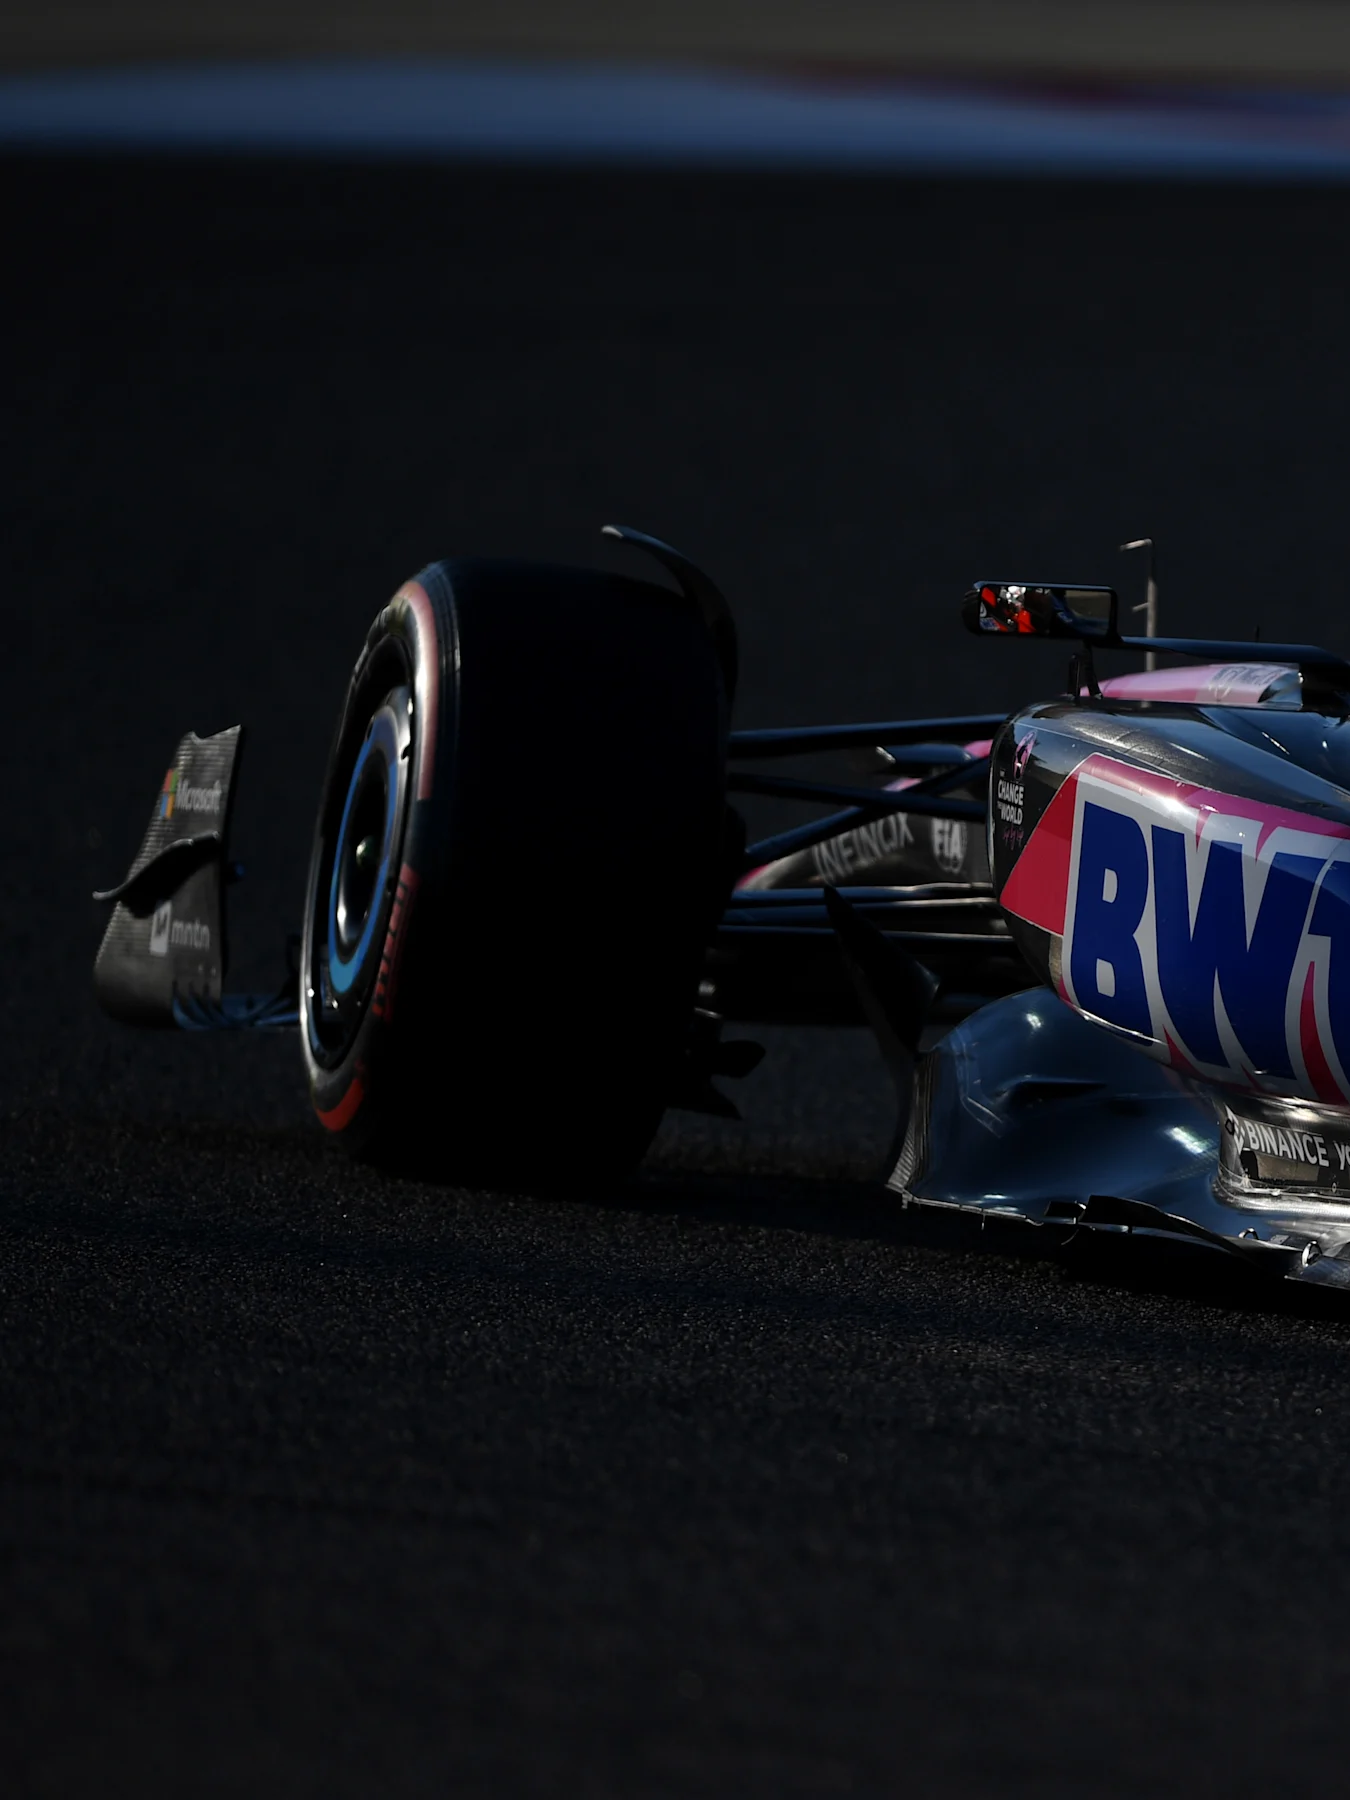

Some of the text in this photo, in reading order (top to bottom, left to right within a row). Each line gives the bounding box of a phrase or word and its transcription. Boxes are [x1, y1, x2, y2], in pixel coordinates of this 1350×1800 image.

[998, 780, 1025, 806] CHANGE
[1001, 805, 1024, 826] WORLD
[1247, 1119, 1330, 1168] BINANCE
